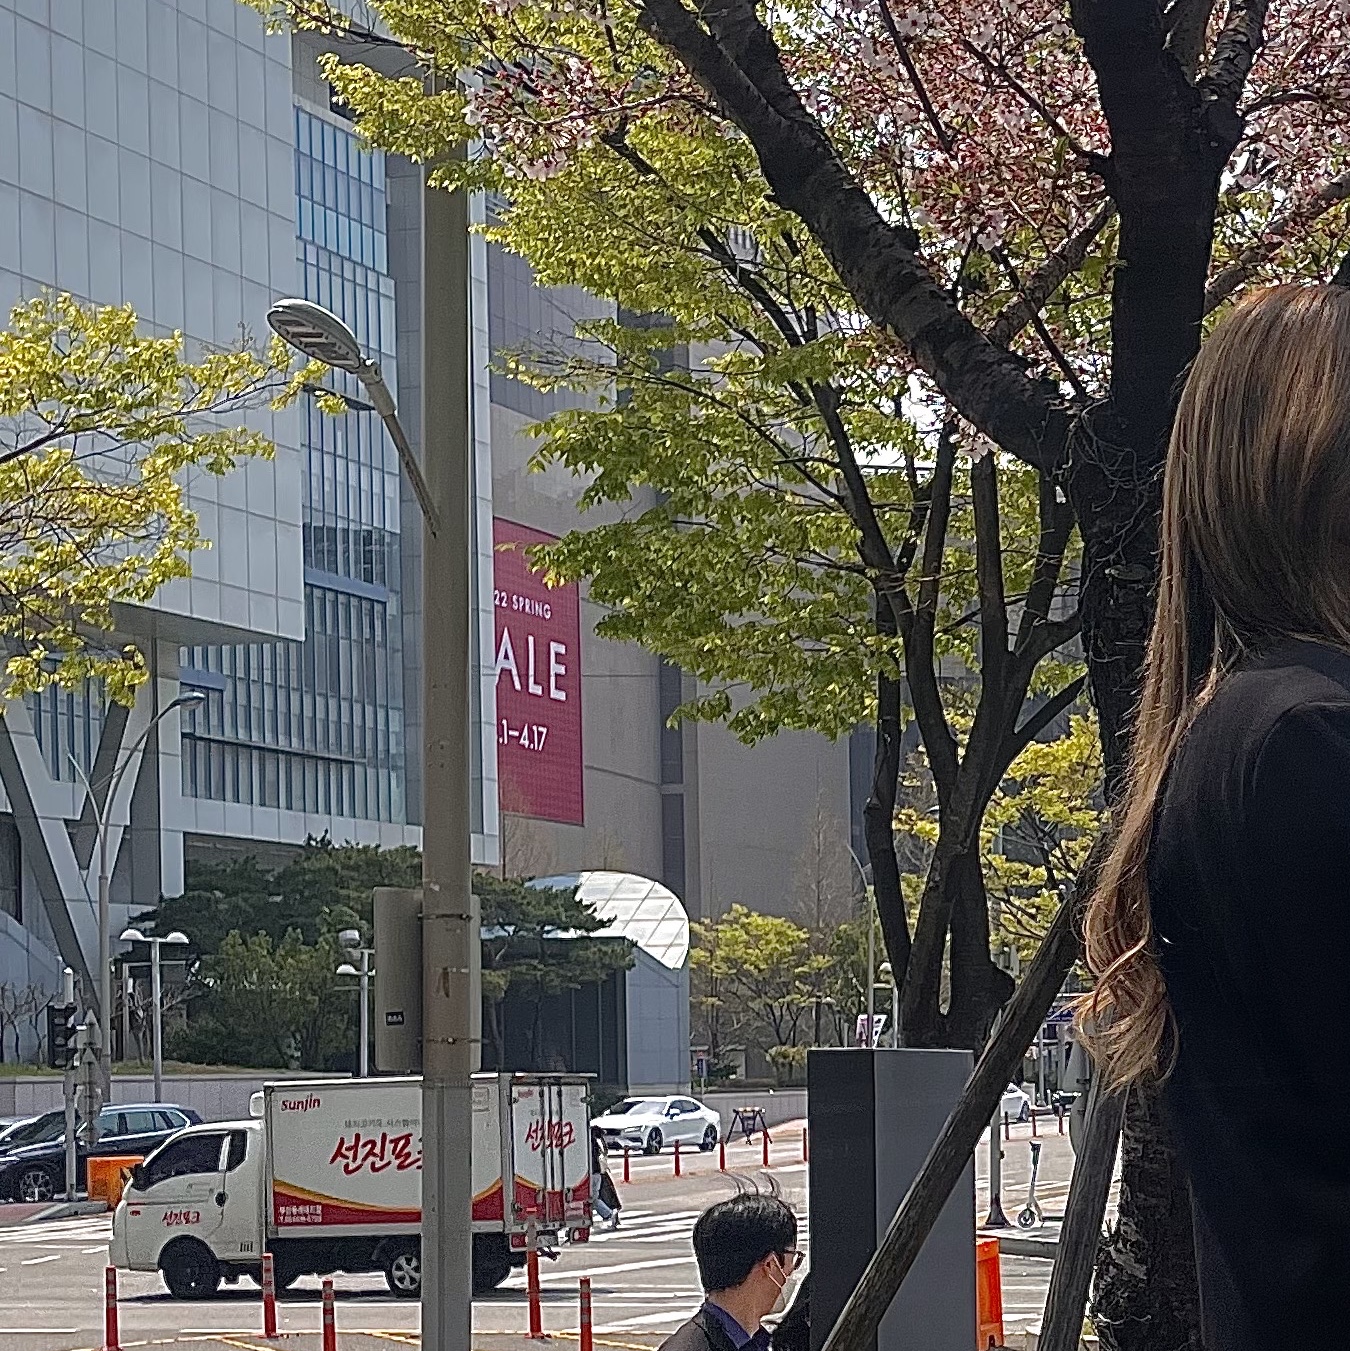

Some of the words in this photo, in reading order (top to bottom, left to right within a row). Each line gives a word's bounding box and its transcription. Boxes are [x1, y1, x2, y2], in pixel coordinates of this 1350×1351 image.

[494, 589, 508, 608] 22
[512, 594, 552, 620] SPRING
[495, 626, 567, 702] ALE
[498, 718, 548, 751] .1-4.17
[281, 1093, 321, 1112] sunjin
[329, 1132, 422, 1175] 선진포
